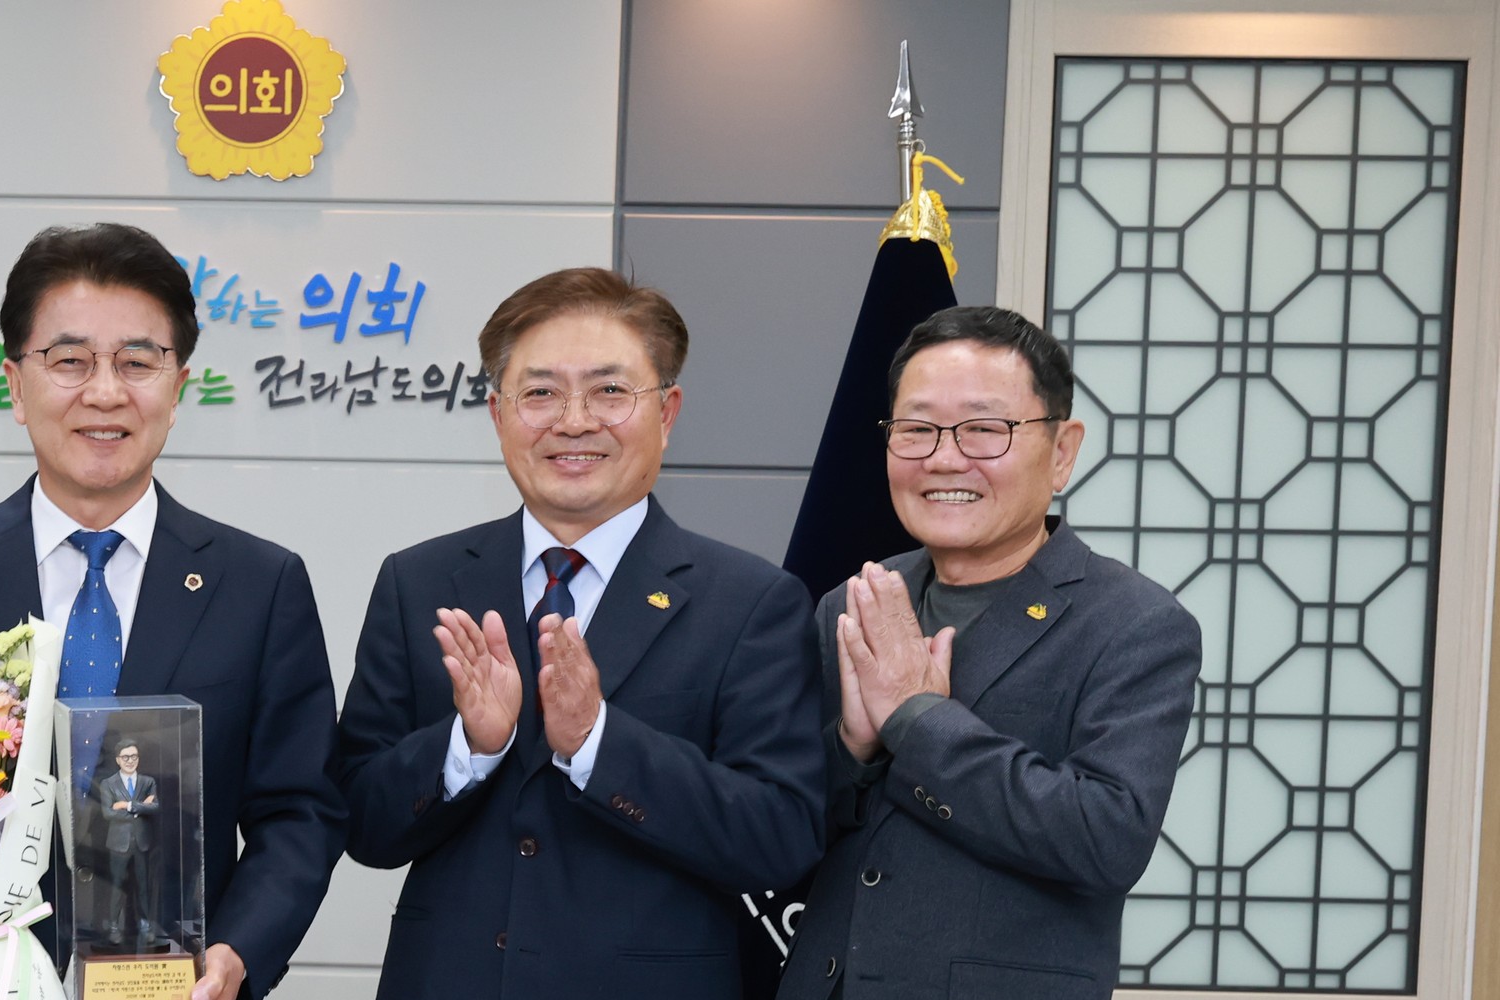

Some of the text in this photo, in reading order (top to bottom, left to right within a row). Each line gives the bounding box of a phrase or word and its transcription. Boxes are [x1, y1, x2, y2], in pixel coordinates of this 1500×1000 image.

[204, 68, 293, 115] 의회
[299, 262, 426, 345] 의회
[21, 824, 43, 866] DE
